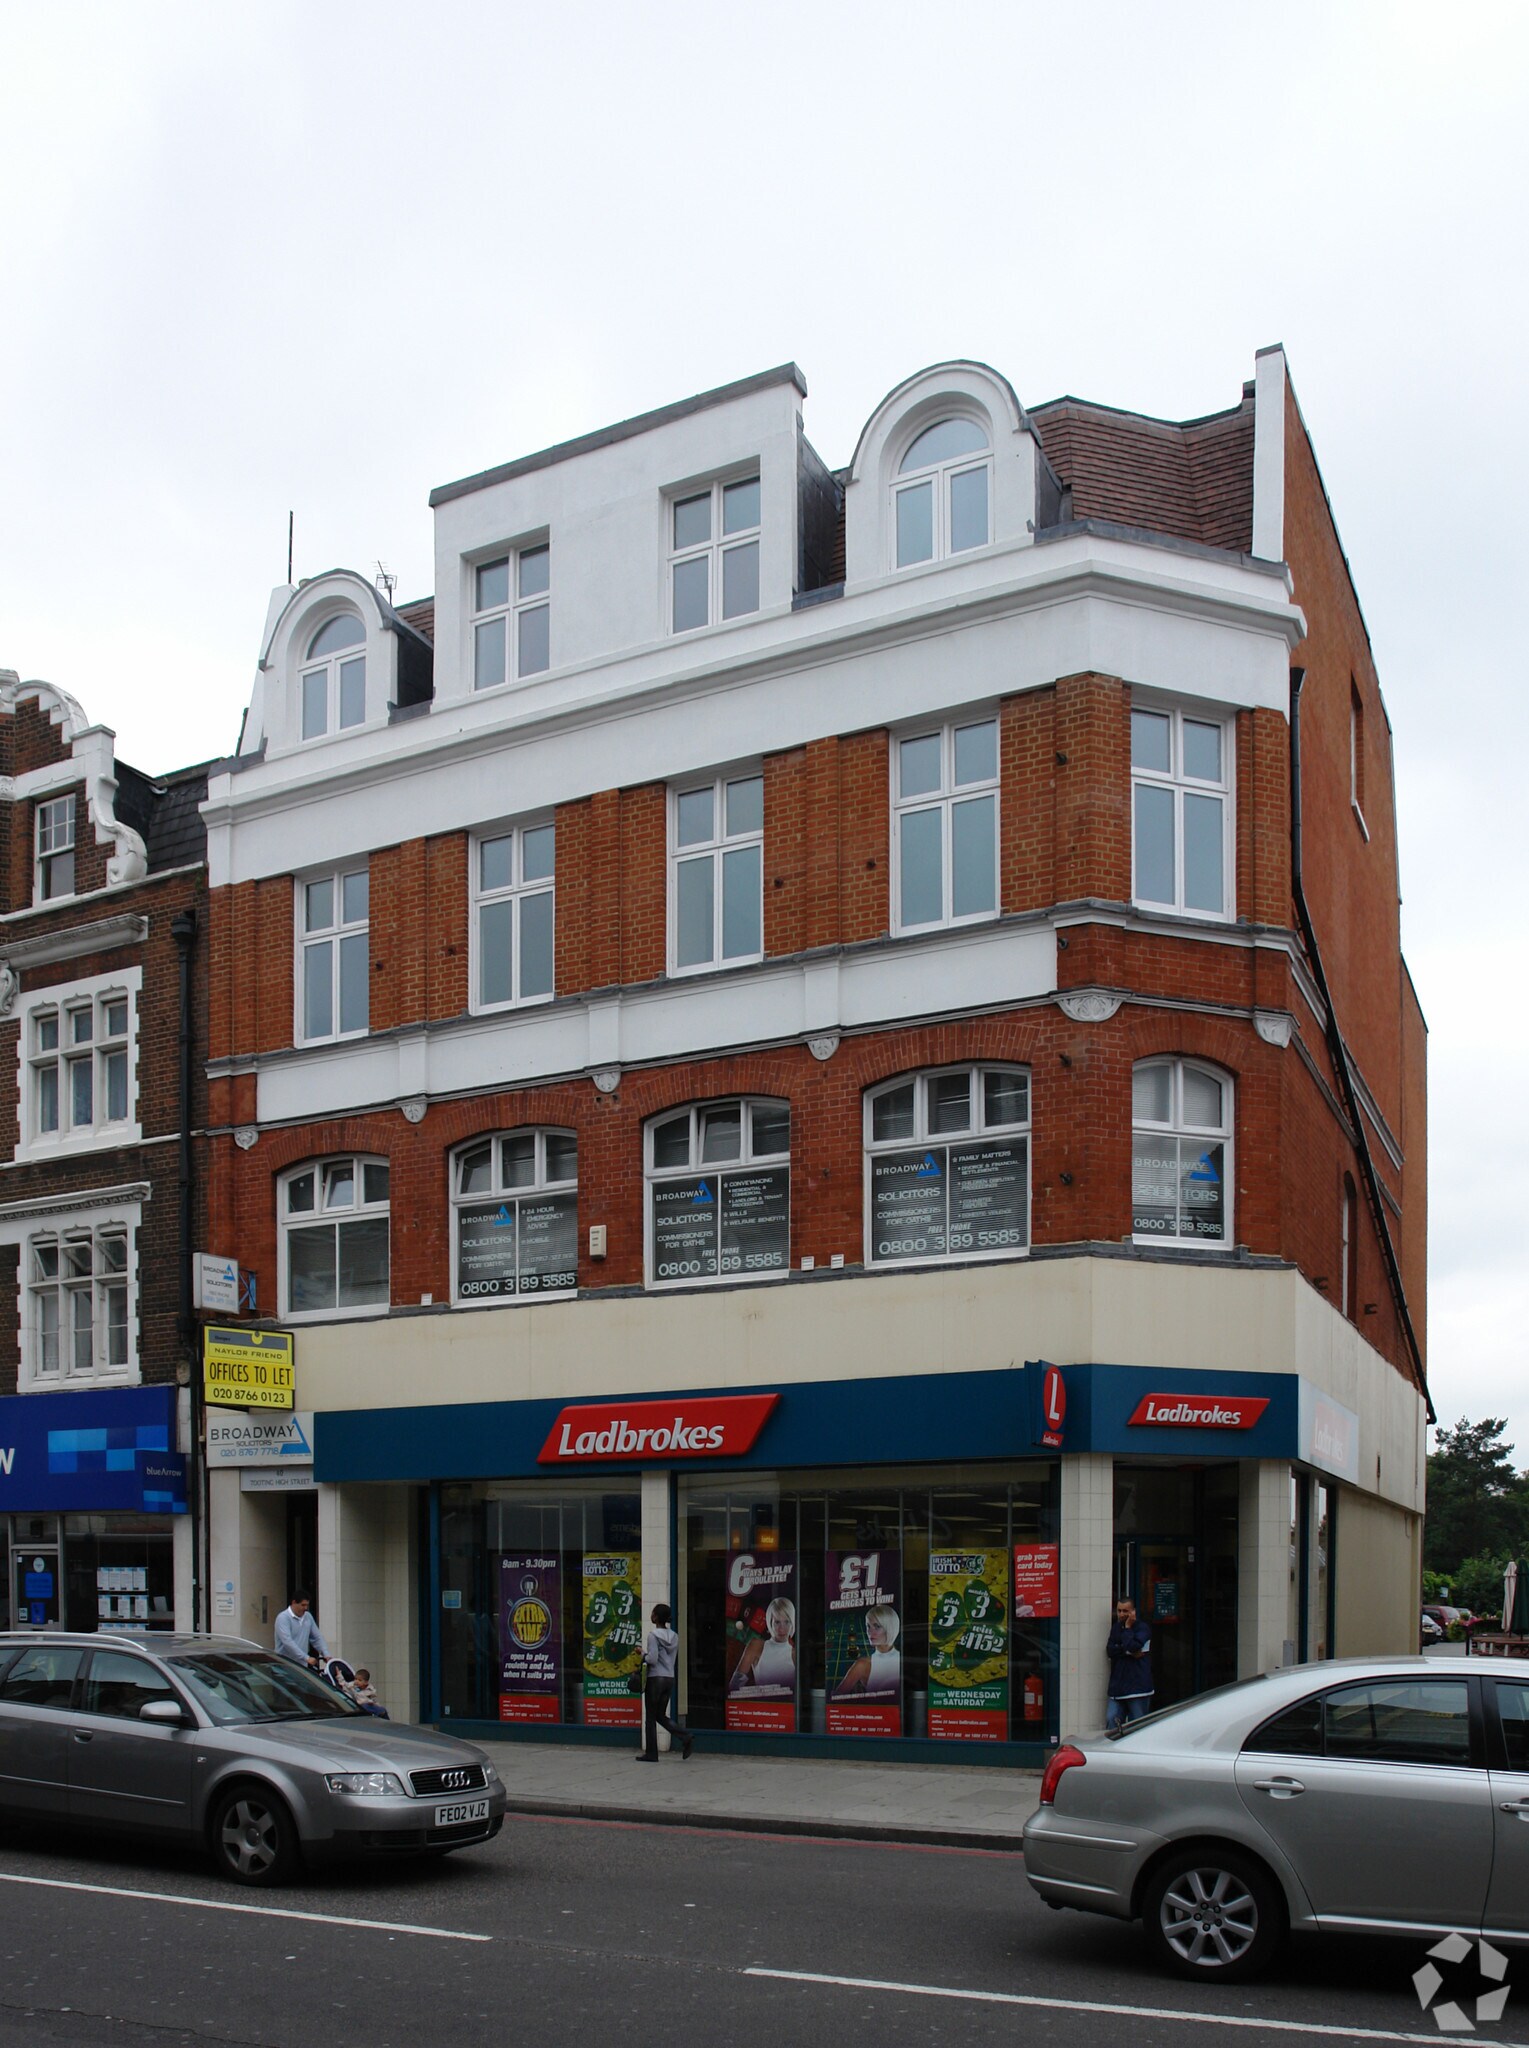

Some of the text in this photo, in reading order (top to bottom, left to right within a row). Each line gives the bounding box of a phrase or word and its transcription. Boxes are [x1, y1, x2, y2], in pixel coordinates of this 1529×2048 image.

[959, 1151, 1011, 1162] FAMILY MATTERS
[876, 1163, 930, 1176] BROADWAY
[1134, 1158, 1209, 1171] BROADWAY
[729, 1178, 773, 1187] CONVEYANCING
[656, 1190, 704, 1201] BROADWAY
[878, 1187, 941, 1202] SOLICITORS
[462, 1214, 504, 1225] BROADWAY
[527, 1213, 564, 1222] EMERGENCY
[657, 1213, 713, 1226] SOLICITORS
[877, 1208, 941, 1219] COMMISSIONERS
[906, 1215, 932, 1224] OATHS
[527, 1222, 549, 1230] ADVICE
[729, 1215, 786, 1226] WELFARE BENEFITS
[1134, 1219, 1222, 1234] 0800 389 5585
[928, 1222, 972, 1234] FREE PHONE
[463, 1236, 512, 1248] SOLICITORS
[527, 1237, 549, 1245] MOBILE
[657, 1231, 713, 1242] COMMISSIONERS
[879, 1230, 1020, 1255] 0800 389 5585
[665, 1239, 705, 1249] FOR OATHS
[462, 1252, 512, 1264] COMMISSIONERS
[702, 1247, 740, 1257] FREE PHONE
[659, 1252, 783, 1276] 0800 389 5585
[203, 1266, 230, 1275] BROADWAY
[207, 1280, 232, 1289] SOLICITORS
[462, 1273, 576, 1295] 0800 389 5585
[215, 1348, 283, 1360] NAYLOR FRIEND
[210, 1362, 291, 1386] OFFICES TO LET
[214, 1388, 285, 1403] 020 8766 0123
[1146, 1402, 1241, 1425] Ladbrokes
[211, 1426, 295, 1441] BROADWAY
[558, 1417, 725, 1456] Ladbrokes
[236, 1440, 272, 1448] SOLICITORS
[221, 1449, 236, 1457] 020
[239, 1448, 259, 1457] 8767
[262, 1447, 280, 1456] 7718
[1017, 1554, 1050, 1562] grab your
[502, 1559, 557, 1570] 9am 9.30pm
[586, 1566, 609, 1575] LOTTO
[932, 1563, 960, 1573] LOTTO
[1018, 1562, 1053, 1570] card today
[730, 1555, 755, 1596] 6
[744, 1565, 793, 1578] WAYS TO PLAY
[840, 1554, 880, 1591] £1
[750, 1573, 787, 1585] ROULETTE!
[841, 1590, 859, 1601] GETS
[860, 1589, 876, 1598] YOU
[618, 1593, 634, 1616] 3
[830, 1594, 894, 1610] CHANCES TO WIN!
[945, 1597, 960, 1606] pick
[971, 1595, 990, 1618] 3
[513, 1603, 547, 1623] EXTRA
[591, 1604, 608, 1624] 3
[939, 1605, 958, 1627] 3
[619, 1621, 636, 1630] win
[973, 1625, 993, 1635] win
[516, 1623, 543, 1643] TIME
[959, 1632, 1005, 1654] £1152
[534, 1653, 549, 1662] play
[529, 1662, 542, 1670] and
[947, 1691, 1001, 1699] WEDNESDAY
[943, 1698, 986, 1707] SATURDAY
[440, 1802, 486, 1823] FE02 VJZ
